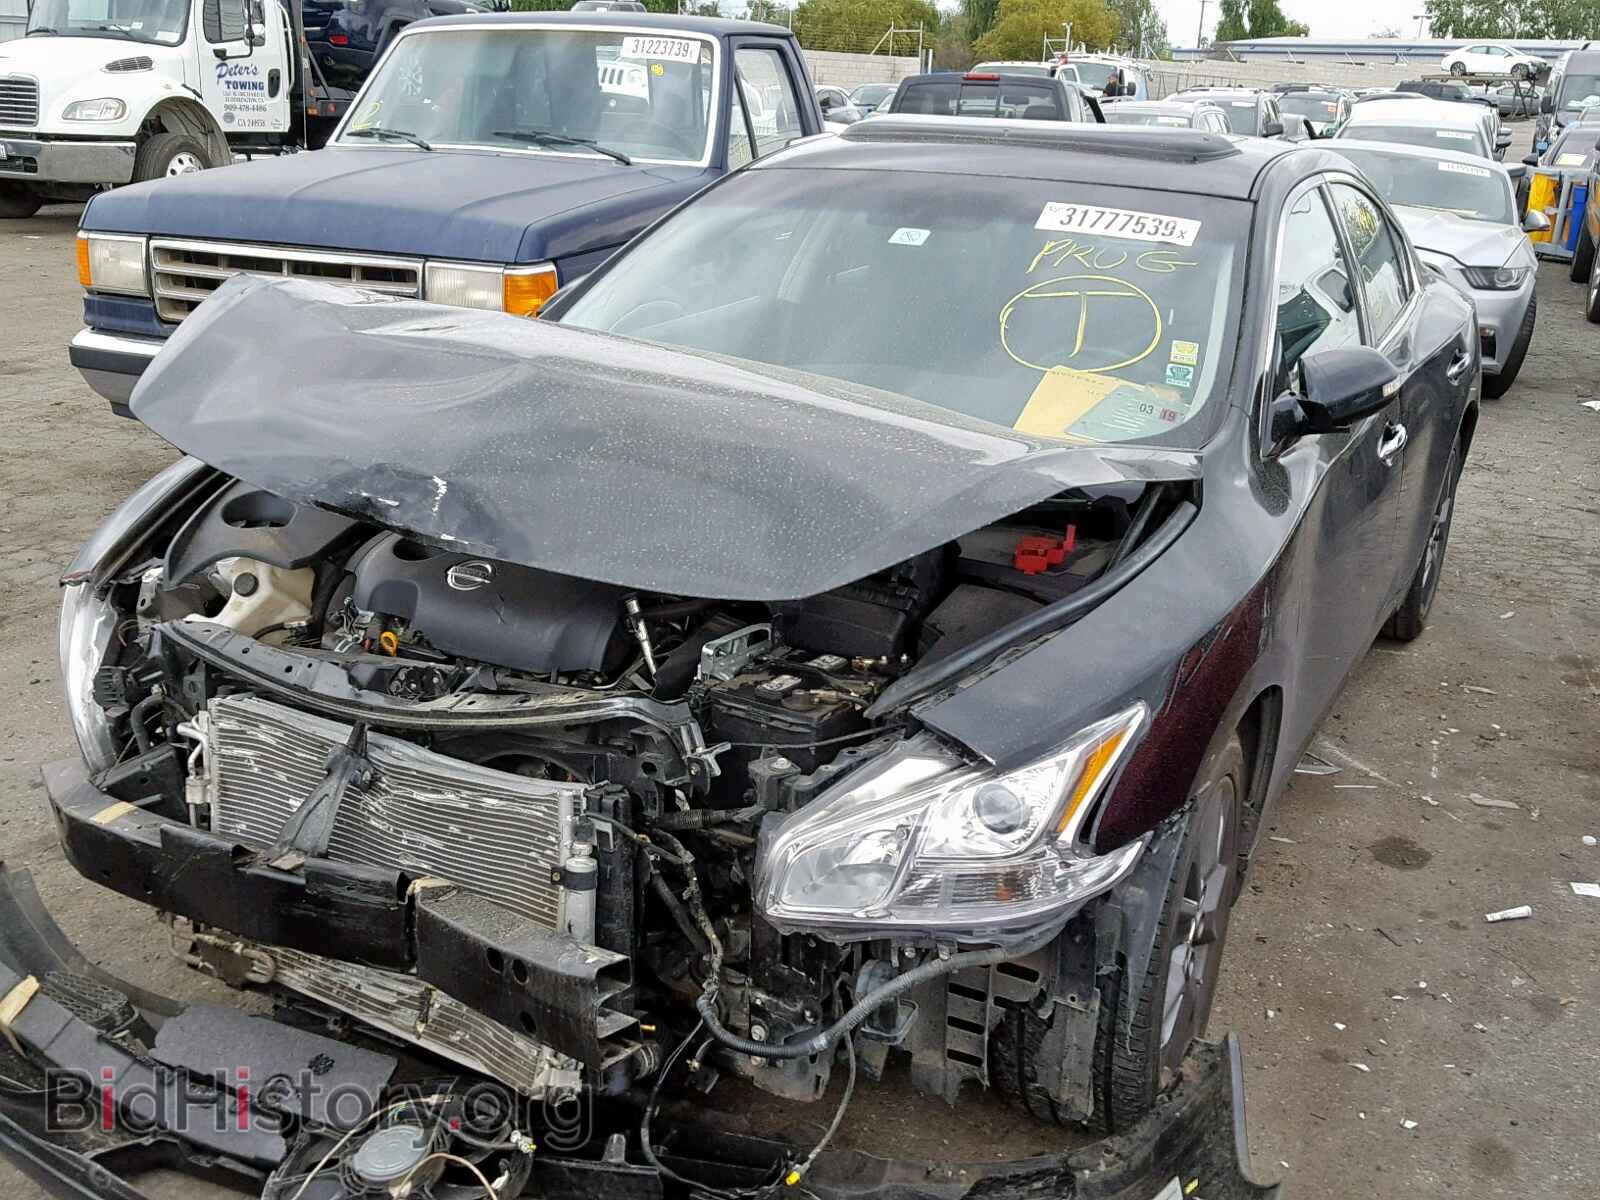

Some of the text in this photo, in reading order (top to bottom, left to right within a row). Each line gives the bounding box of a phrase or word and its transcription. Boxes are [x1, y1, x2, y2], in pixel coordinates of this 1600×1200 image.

[216, 62, 258, 85] Peter's
[224, 80, 265, 91] TOWING
[1139, 403, 1154, 415] 03
